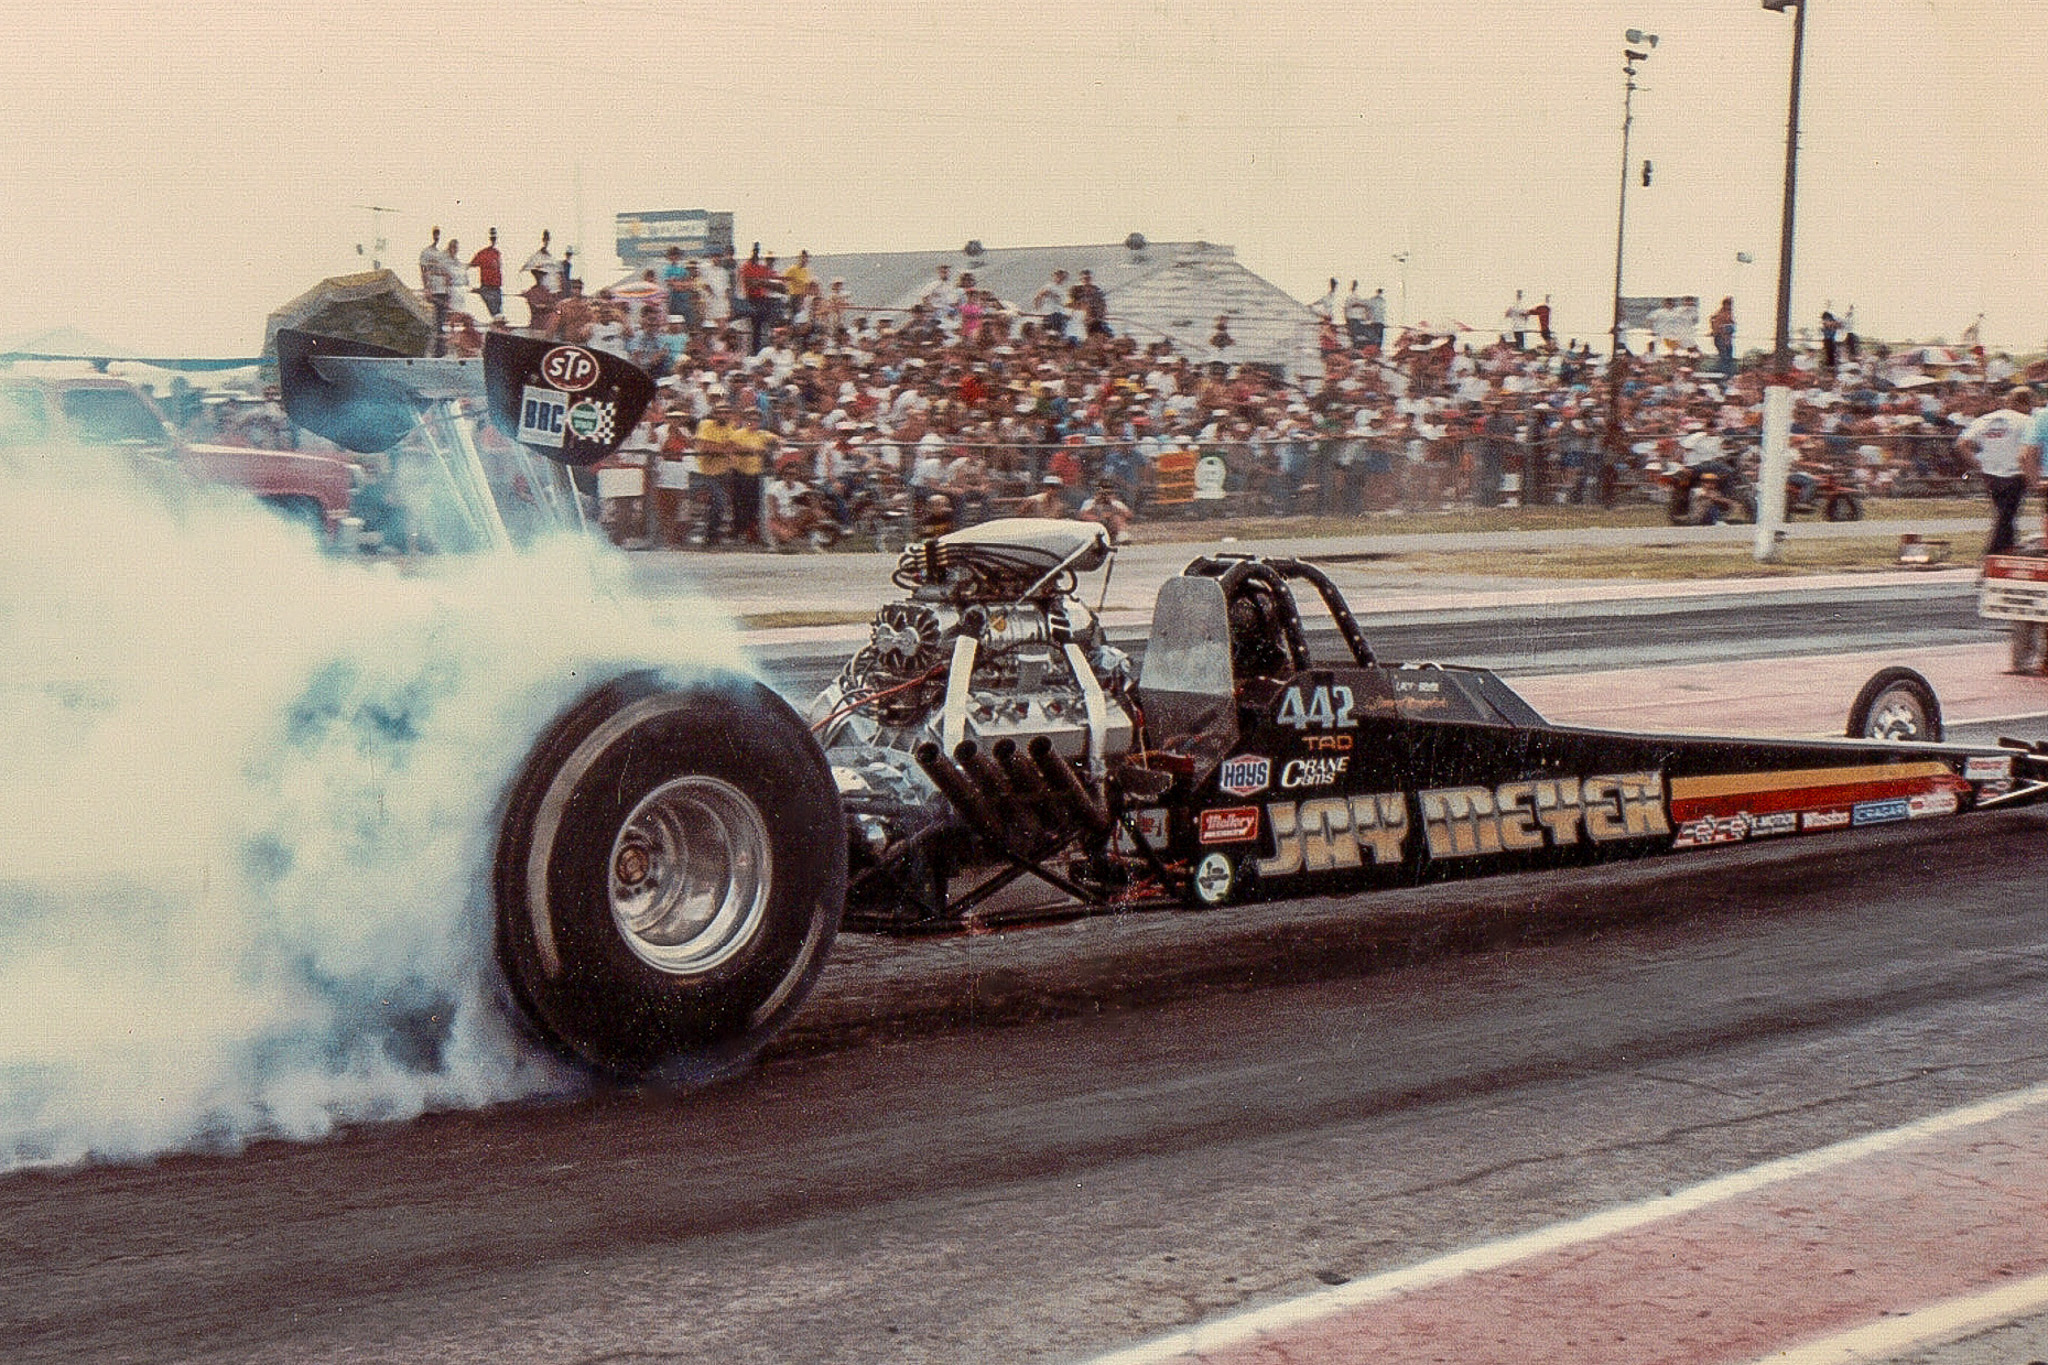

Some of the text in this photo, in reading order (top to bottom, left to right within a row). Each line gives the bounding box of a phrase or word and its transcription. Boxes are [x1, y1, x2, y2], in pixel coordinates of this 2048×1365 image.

[549, 351, 591, 380] STP
[1277, 685, 1359, 730] 442
[1257, 792, 1408, 877] JAY
[1418, 771, 1669, 860] MEYER
